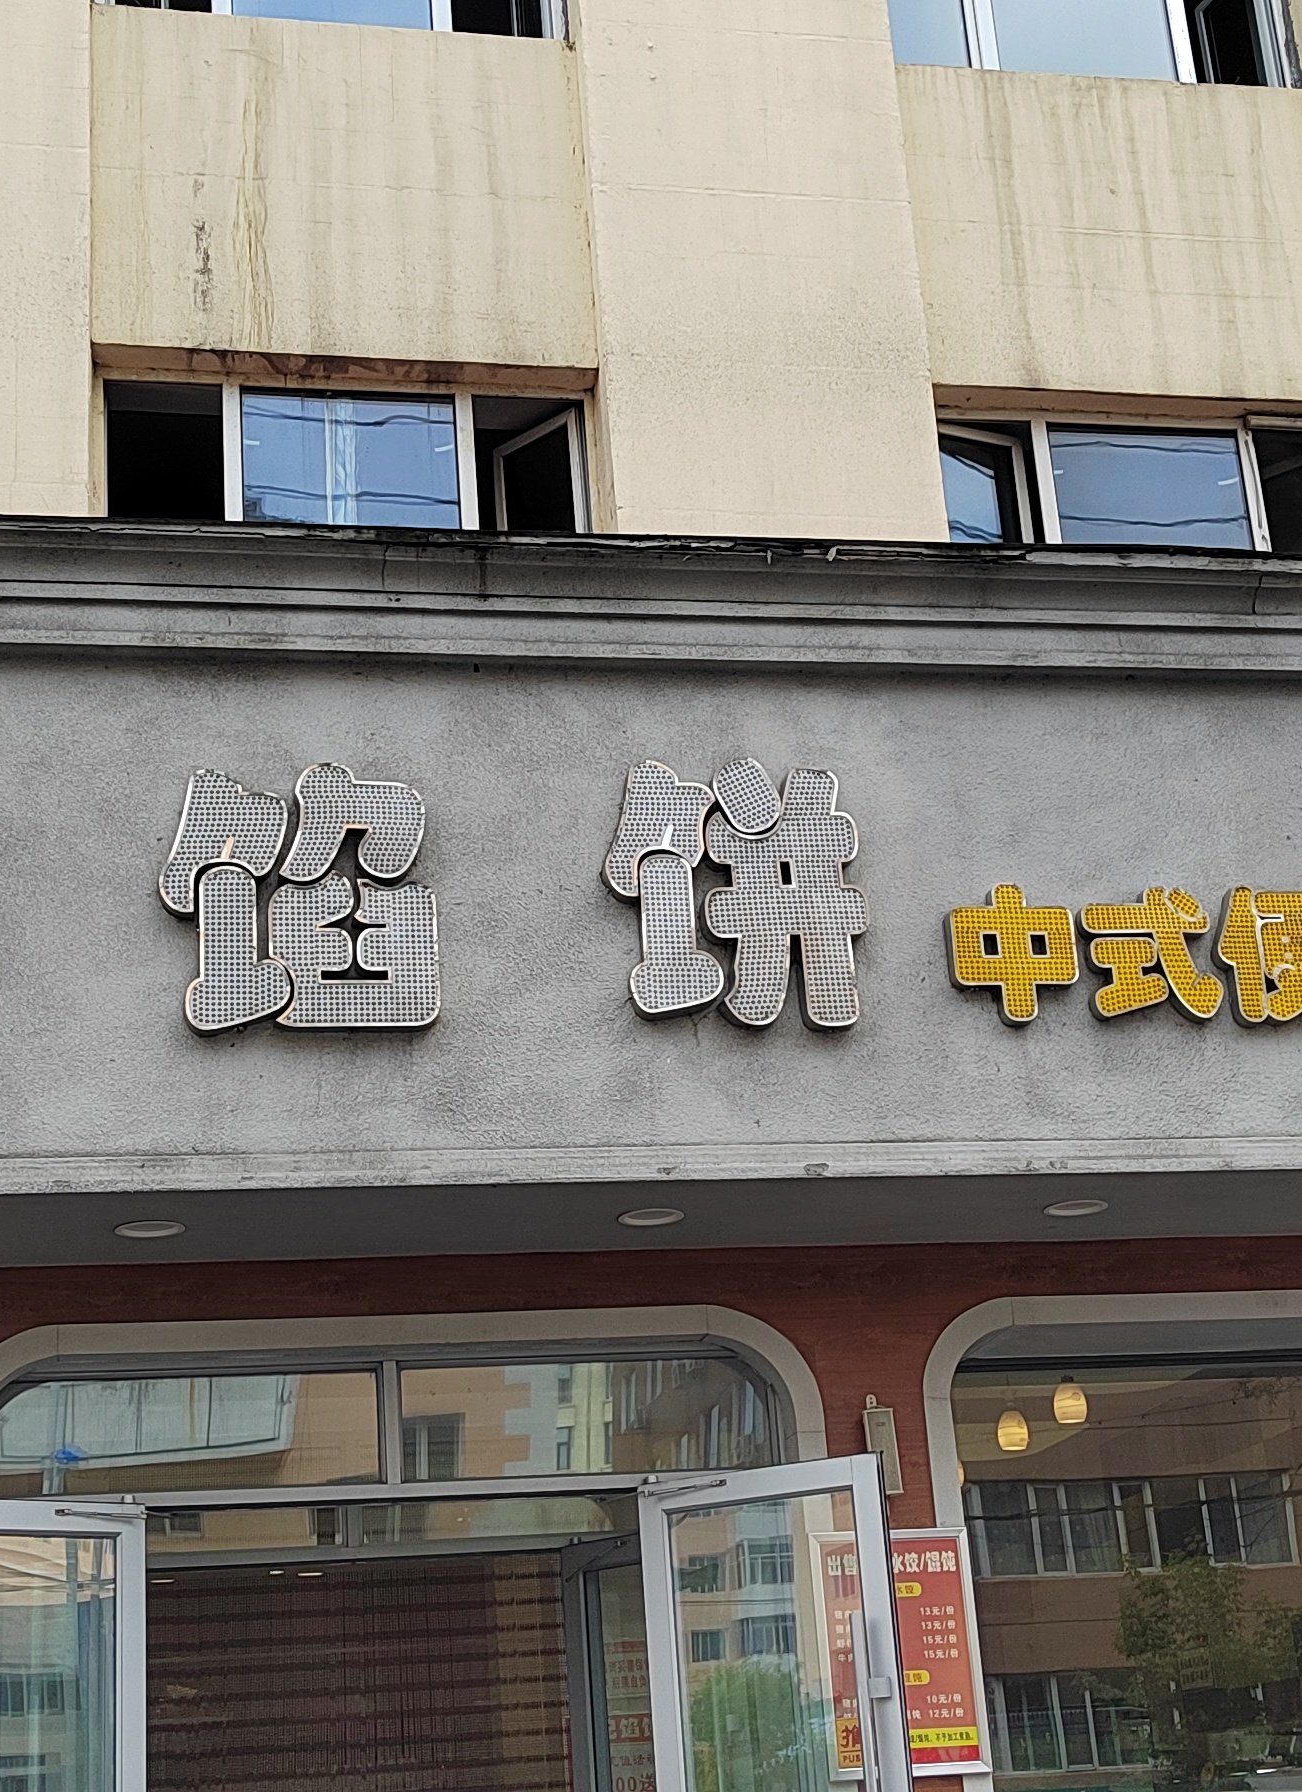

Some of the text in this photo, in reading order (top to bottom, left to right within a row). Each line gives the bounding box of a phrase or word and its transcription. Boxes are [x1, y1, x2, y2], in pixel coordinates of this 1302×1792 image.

[919, 1605, 955, 1616] 13元/份
[921, 1620, 956, 1631] 13元/份
[922, 1634, 957, 1645] 15元/份
[924, 1649, 959, 1660] 15元/份
[926, 1693, 962, 1705] 10元/份
[928, 1707, 964, 1719] 12元/份
